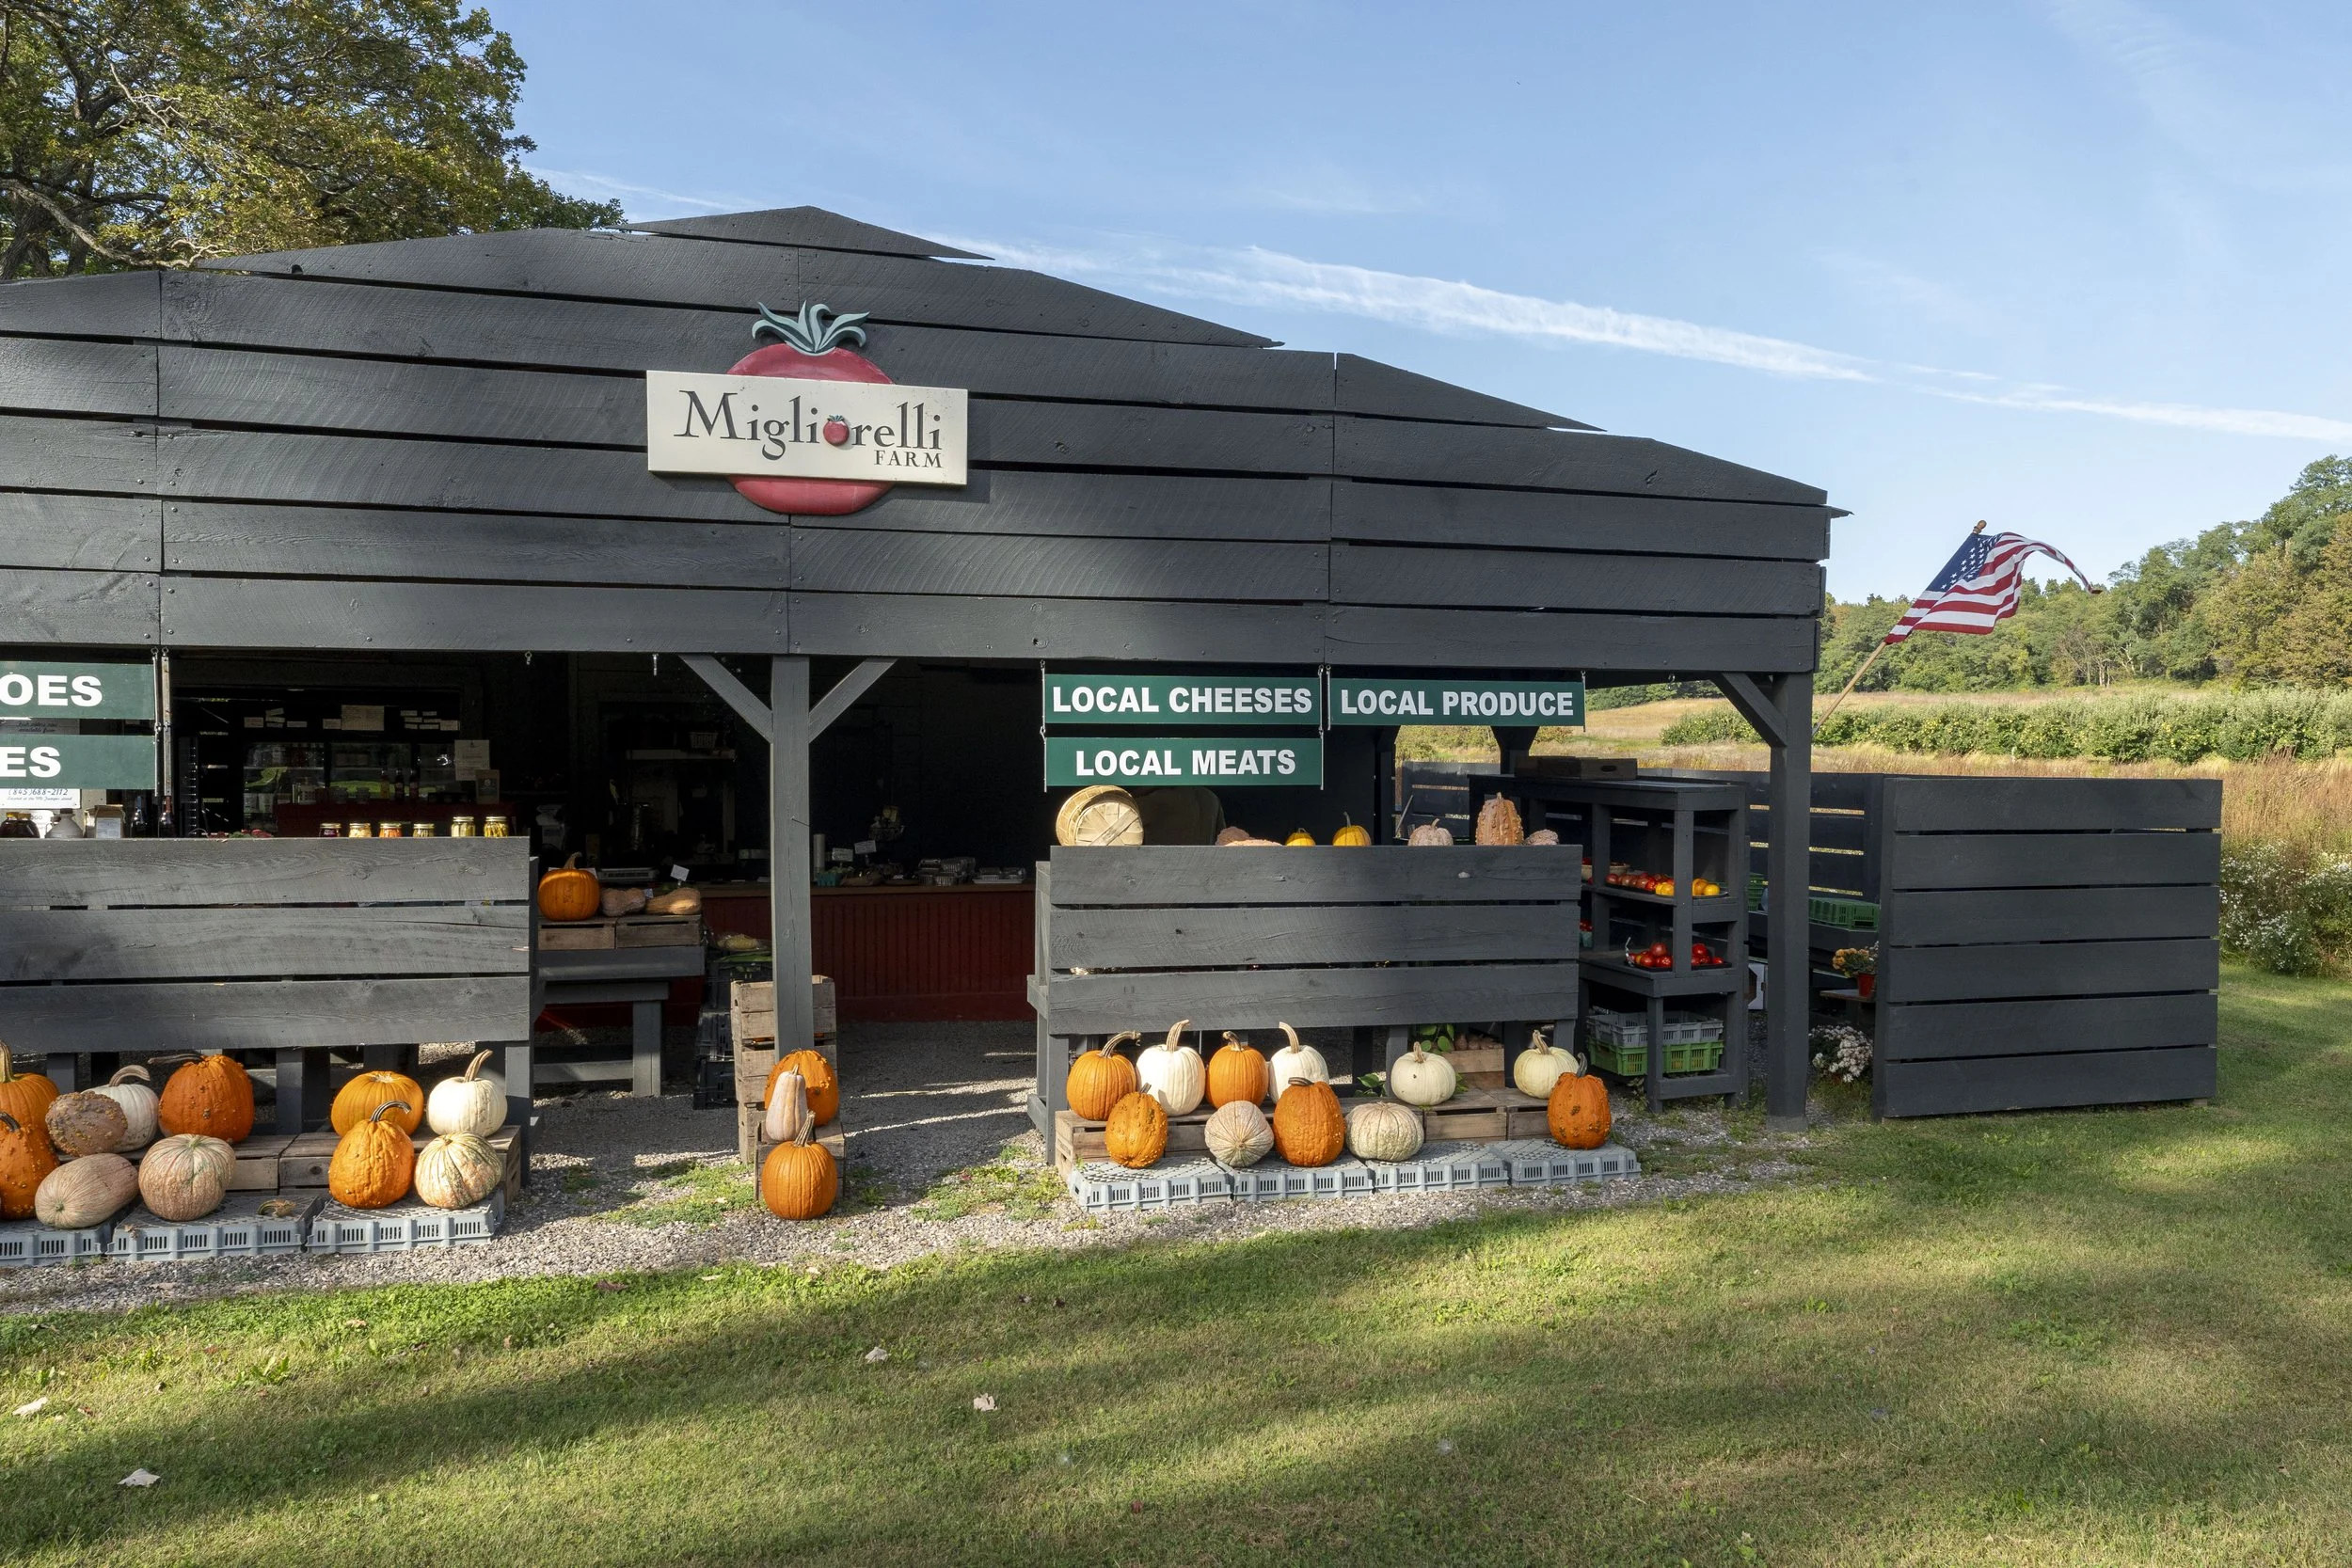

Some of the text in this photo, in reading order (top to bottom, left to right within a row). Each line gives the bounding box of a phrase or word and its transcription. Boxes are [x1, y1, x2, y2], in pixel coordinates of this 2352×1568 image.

[874, 450, 944, 468] FARM
[0, 673, 103, 707] OES
[1053, 687, 1312, 713] LOCAL CHEESES
[1341, 689, 1574, 716] LOCAL PRODUCE
[0, 747, 61, 778] ES
[1076, 749, 1296, 776] LOCAL MEATS
